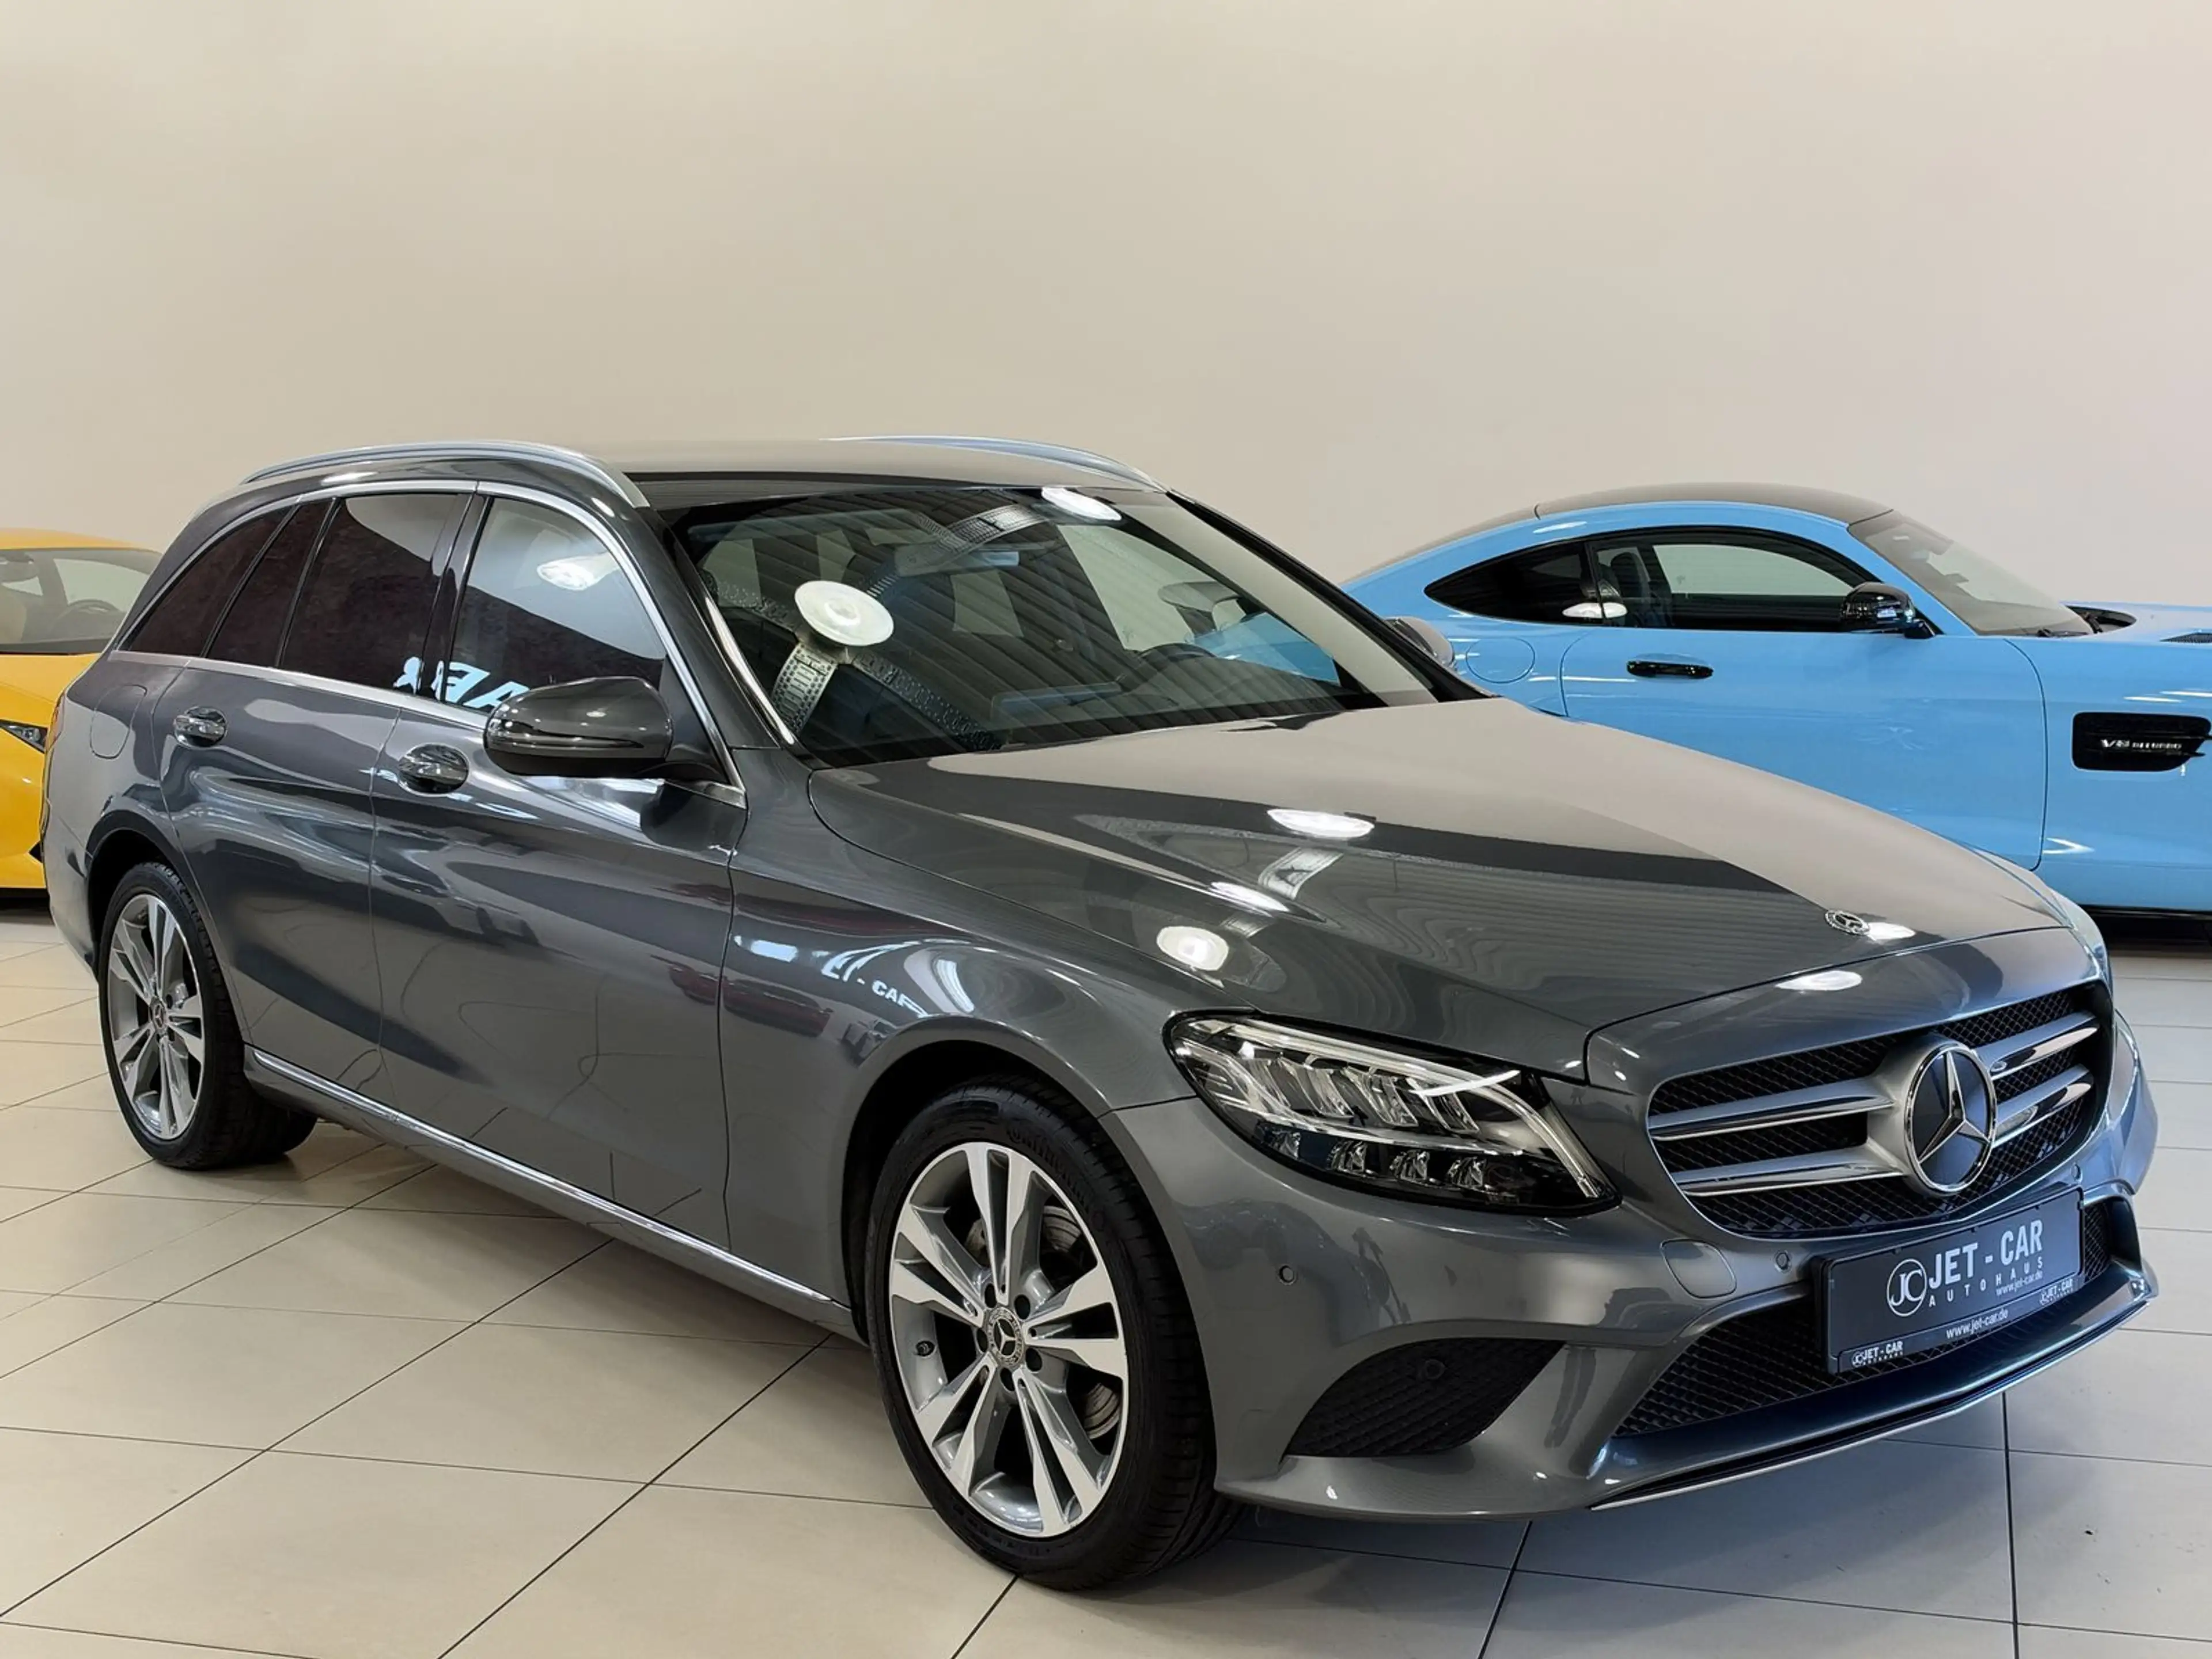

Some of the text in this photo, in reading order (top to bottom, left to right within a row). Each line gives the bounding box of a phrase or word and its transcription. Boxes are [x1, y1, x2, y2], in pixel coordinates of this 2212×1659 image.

[2100, 739, 2130, 748] V8
[1929, 1242, 1978, 1289] JET
[2000, 1219, 2043, 1266] CAR
